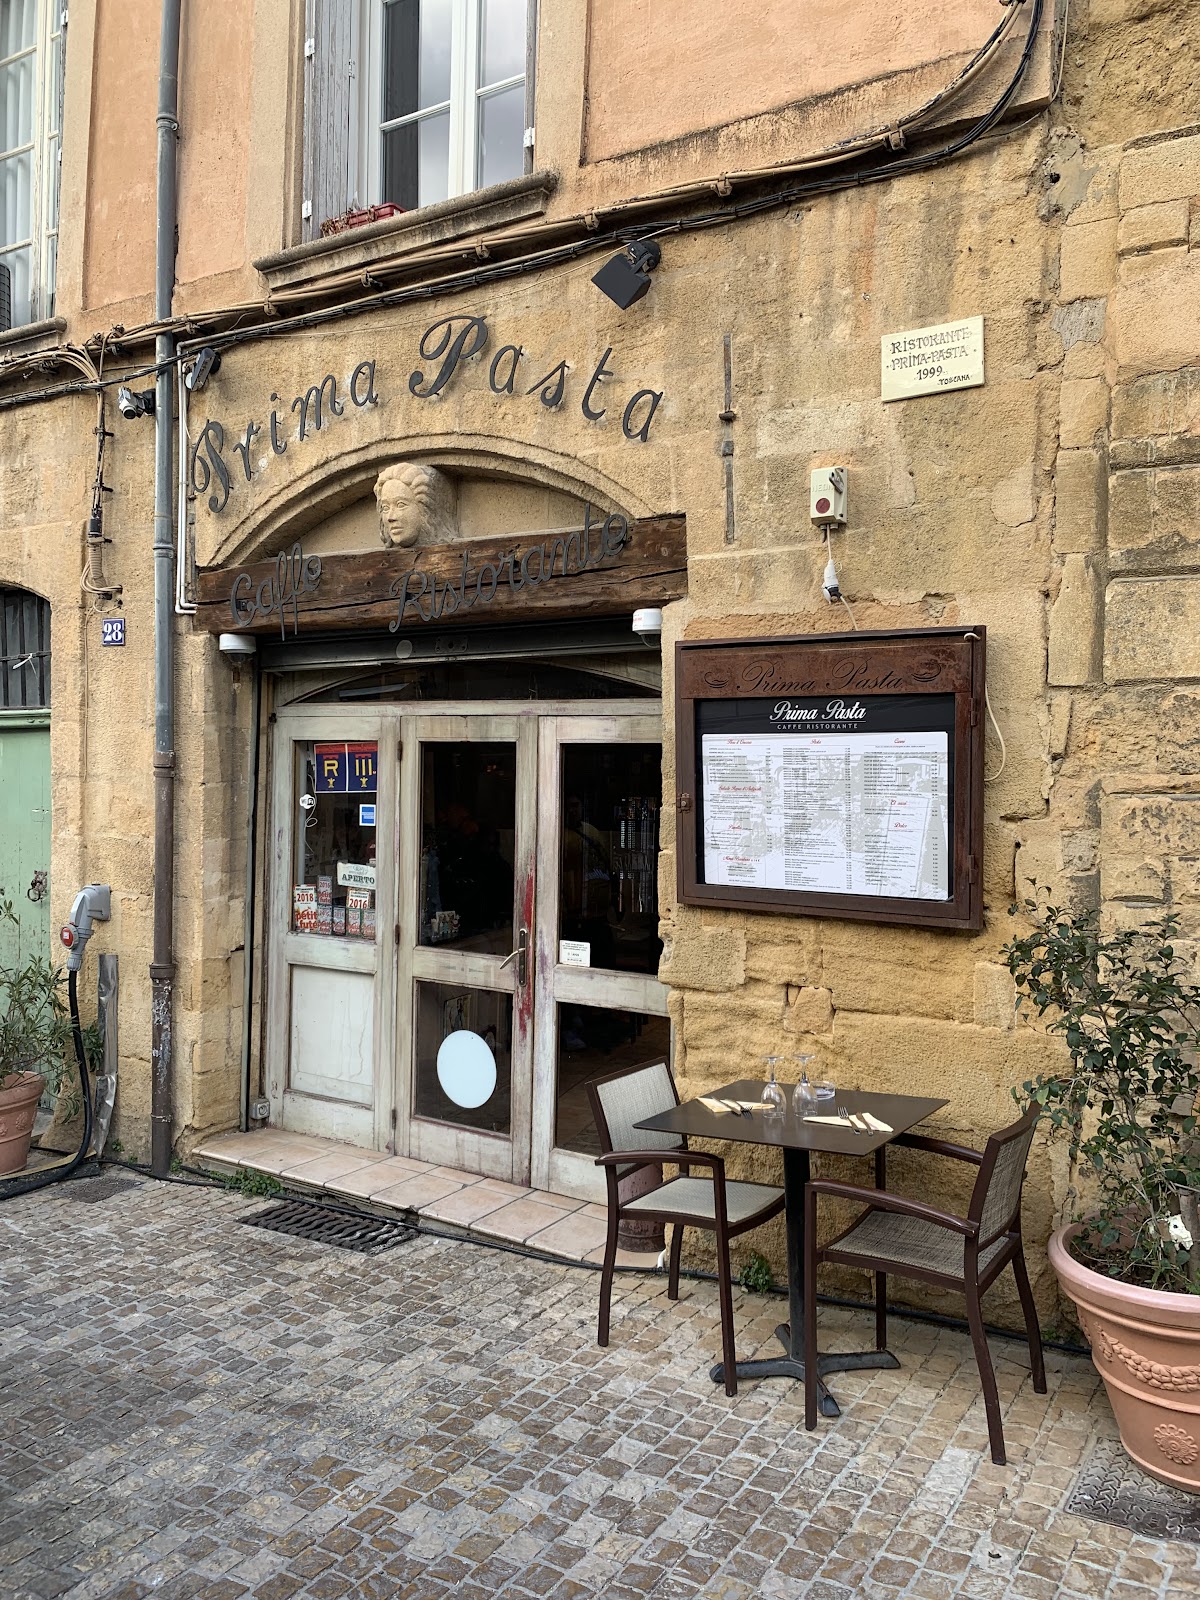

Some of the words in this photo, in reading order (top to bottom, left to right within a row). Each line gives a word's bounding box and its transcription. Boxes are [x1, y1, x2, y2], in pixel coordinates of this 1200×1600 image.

[891, 327, 972, 354] RISTORANTE
[408, 315, 664, 442] Pasta
[916, 365, 943, 381] 1999
[938, 374, 970, 386] TOSCANA
[388, 503, 628, 633] Ristorante
[103, 622, 122, 641] 28
[736, 659, 816, 692] Prima
[826, 655, 904, 690] Pasta
[769, 700, 819, 721] Prima
[821, 699, 867, 720] Pasta
[323, 759, 339, 777] R
[341, 873, 375, 885] APERTO
[296, 893, 314, 902] 2018
[349, 898, 368, 909] 2016
